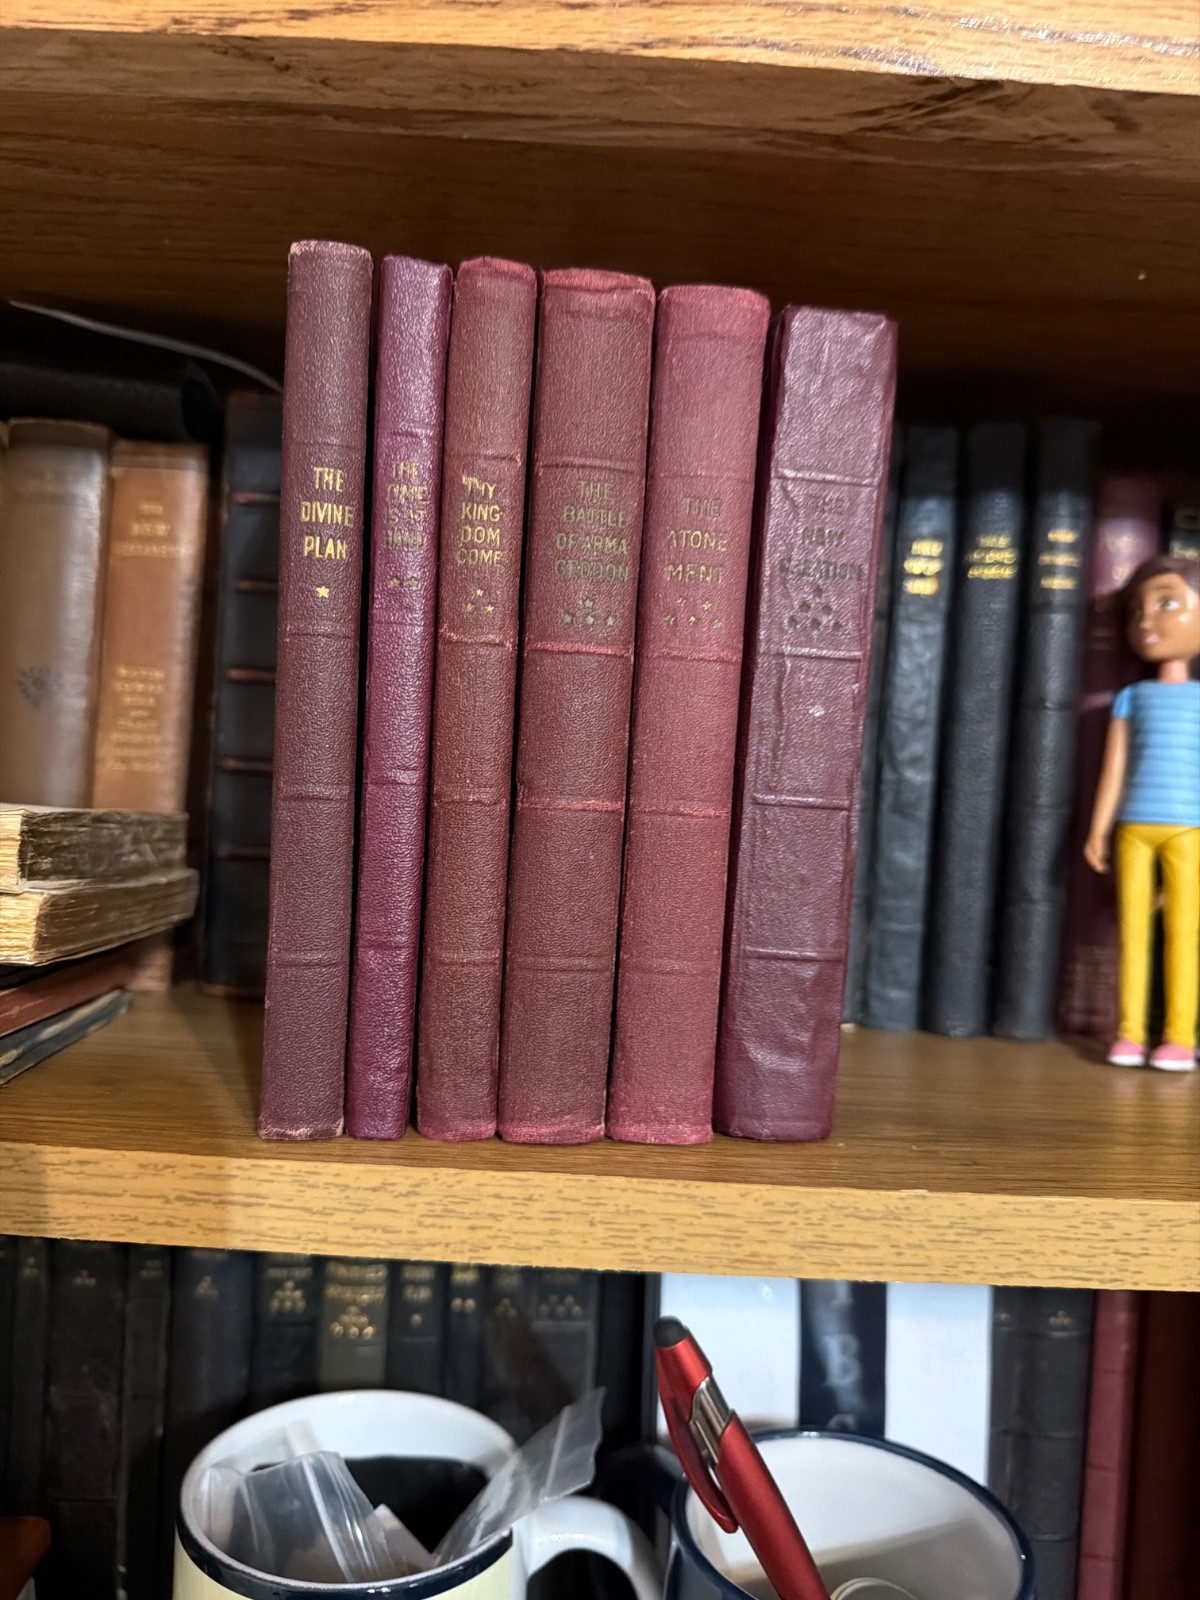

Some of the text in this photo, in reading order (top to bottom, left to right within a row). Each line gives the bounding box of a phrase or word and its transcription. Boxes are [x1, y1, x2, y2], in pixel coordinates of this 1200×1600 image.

[313, 466, 345, 492] THE
[391, 460, 420, 480] THE
[578, 480, 614, 501] THE
[301, 501, 354, 528] DIVINE
[563, 505, 629, 529] BATTLE
[682, 497, 722, 517] THE
[461, 526, 501, 545] DOM
[556, 533, 579, 551] OF
[303, 535, 347, 560] PLAN
[457, 547, 502, 567] COME
